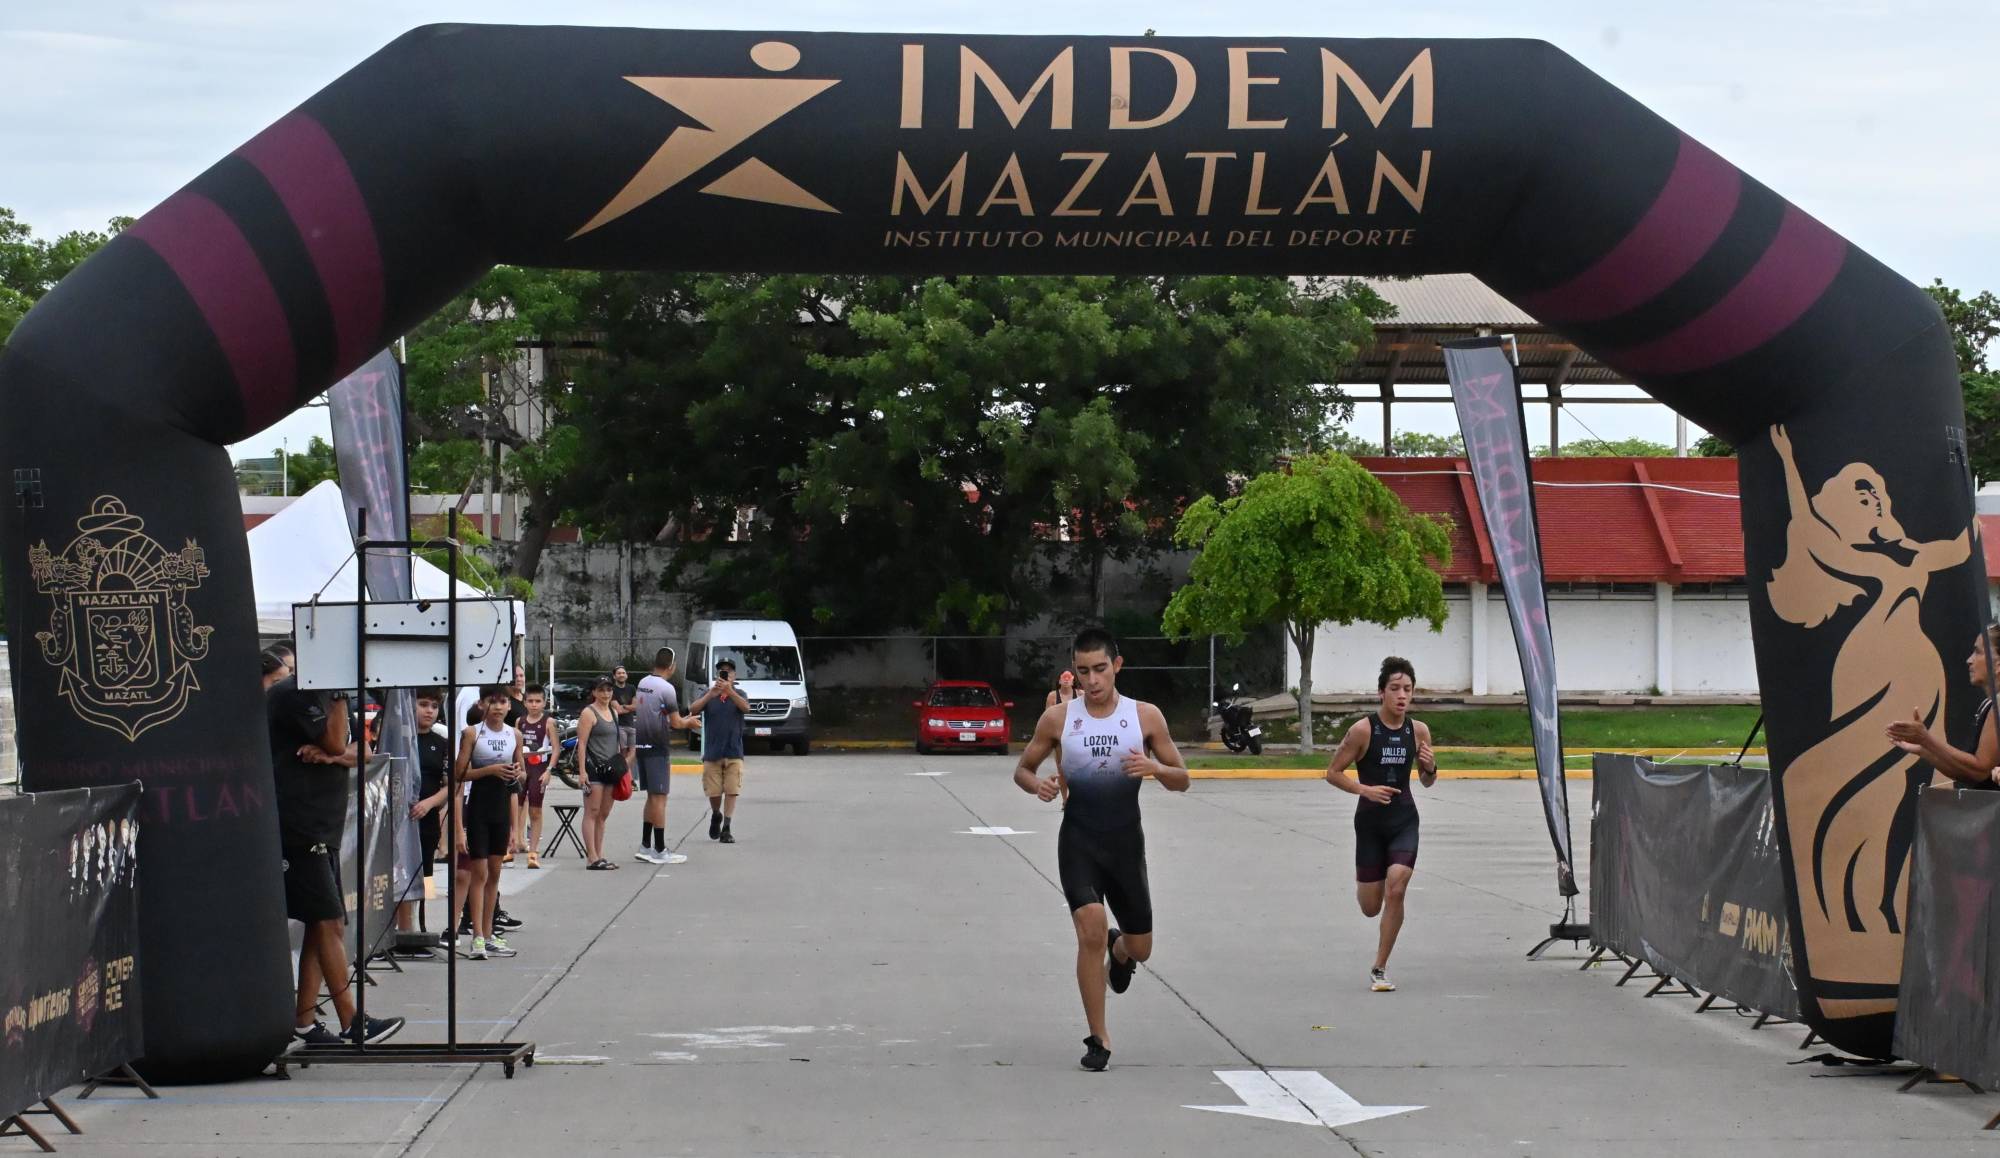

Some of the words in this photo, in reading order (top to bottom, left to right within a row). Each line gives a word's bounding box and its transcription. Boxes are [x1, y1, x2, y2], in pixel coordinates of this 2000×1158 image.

[900, 43, 1434, 130] IMDEM
[890, 134, 1432, 216] MAZATLÁN
[883, 230, 1043, 248] INSTITUTO
[1055, 229, 1213, 248] MUNICIPAL
[1225, 230, 1275, 247] DEL
[1287, 228, 1416, 246] DEPORTE
[78, 593, 160, 606] MAZATLAN
[104, 691, 151, 700] MAZATL
[1083, 735, 1119, 747] LOZOYA
[1091, 746, 1112, 758] MAZ
[1382, 747, 1407, 757] VALLEJO
